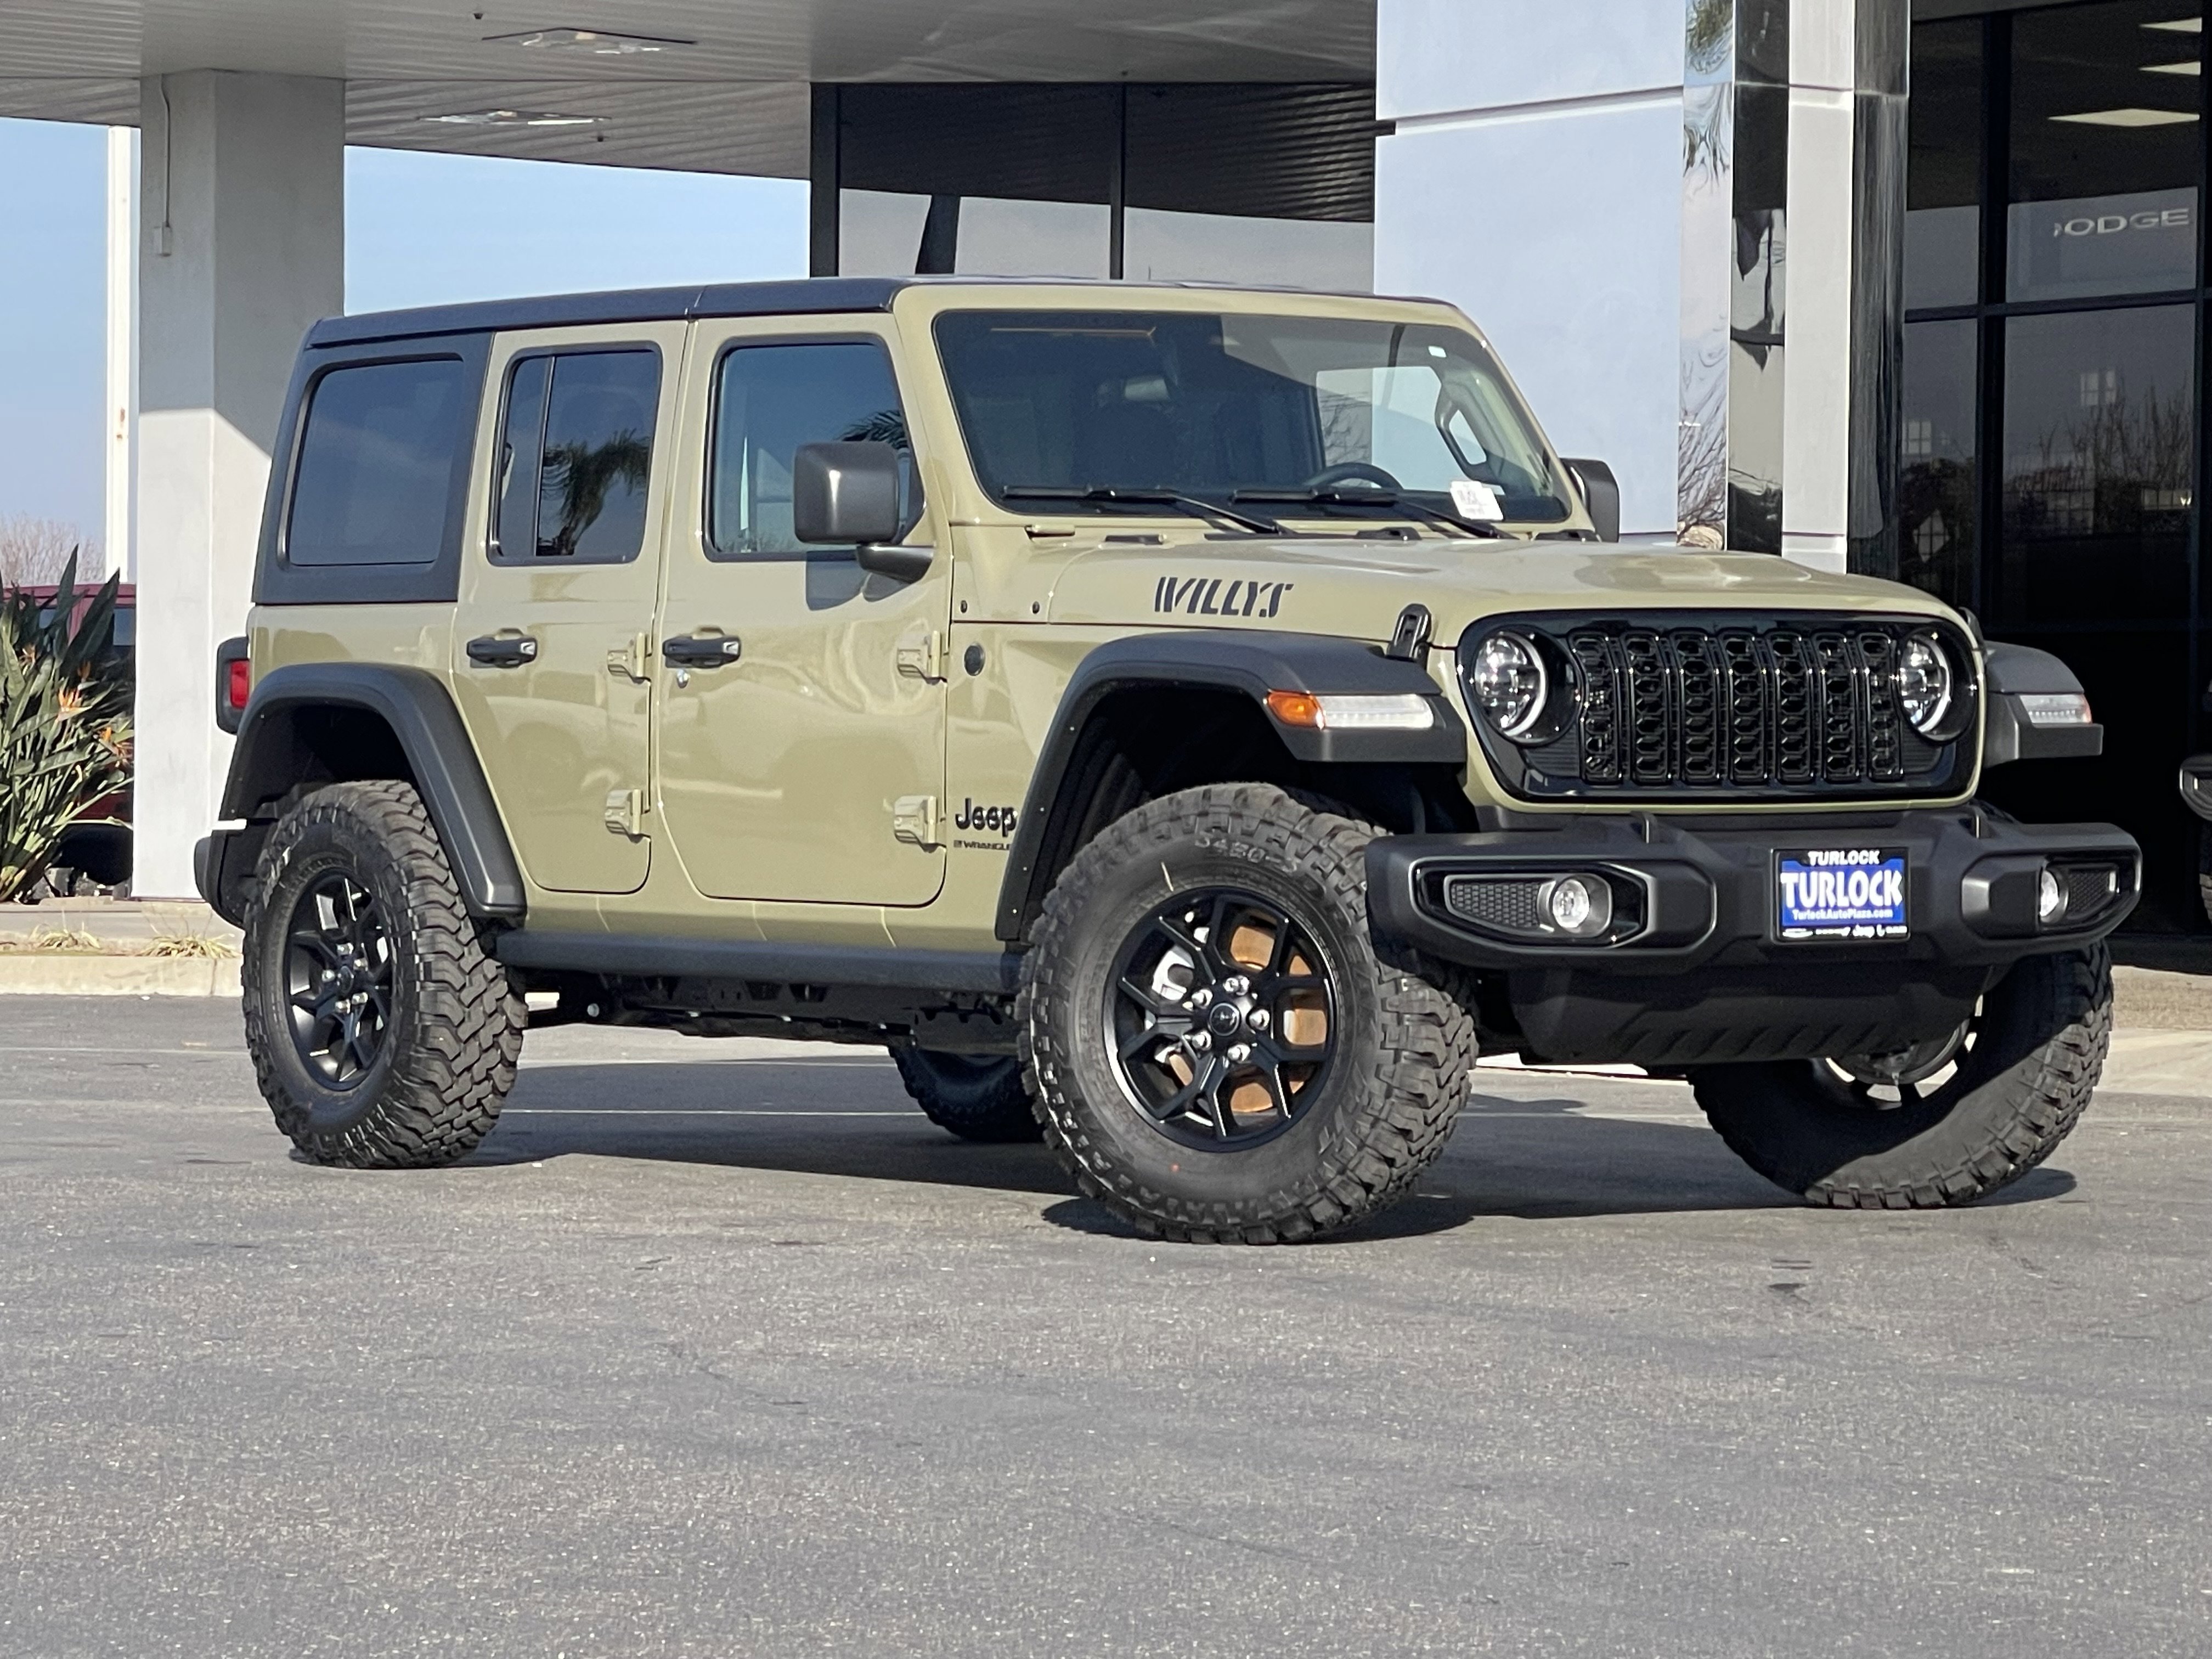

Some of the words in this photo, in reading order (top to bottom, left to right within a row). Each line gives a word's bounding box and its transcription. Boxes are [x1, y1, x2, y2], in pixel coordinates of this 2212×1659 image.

[2053, 208, 2190, 238] ODGE
[1154, 576, 1294, 618] WILLYS
[955, 797, 1018, 838] Jeep
[1808, 850, 1880, 866] TURLOCK
[1780, 869, 1903, 909] TURLOCK
[1792, 909, 1894, 921] TurlockAutoPlaza.com
